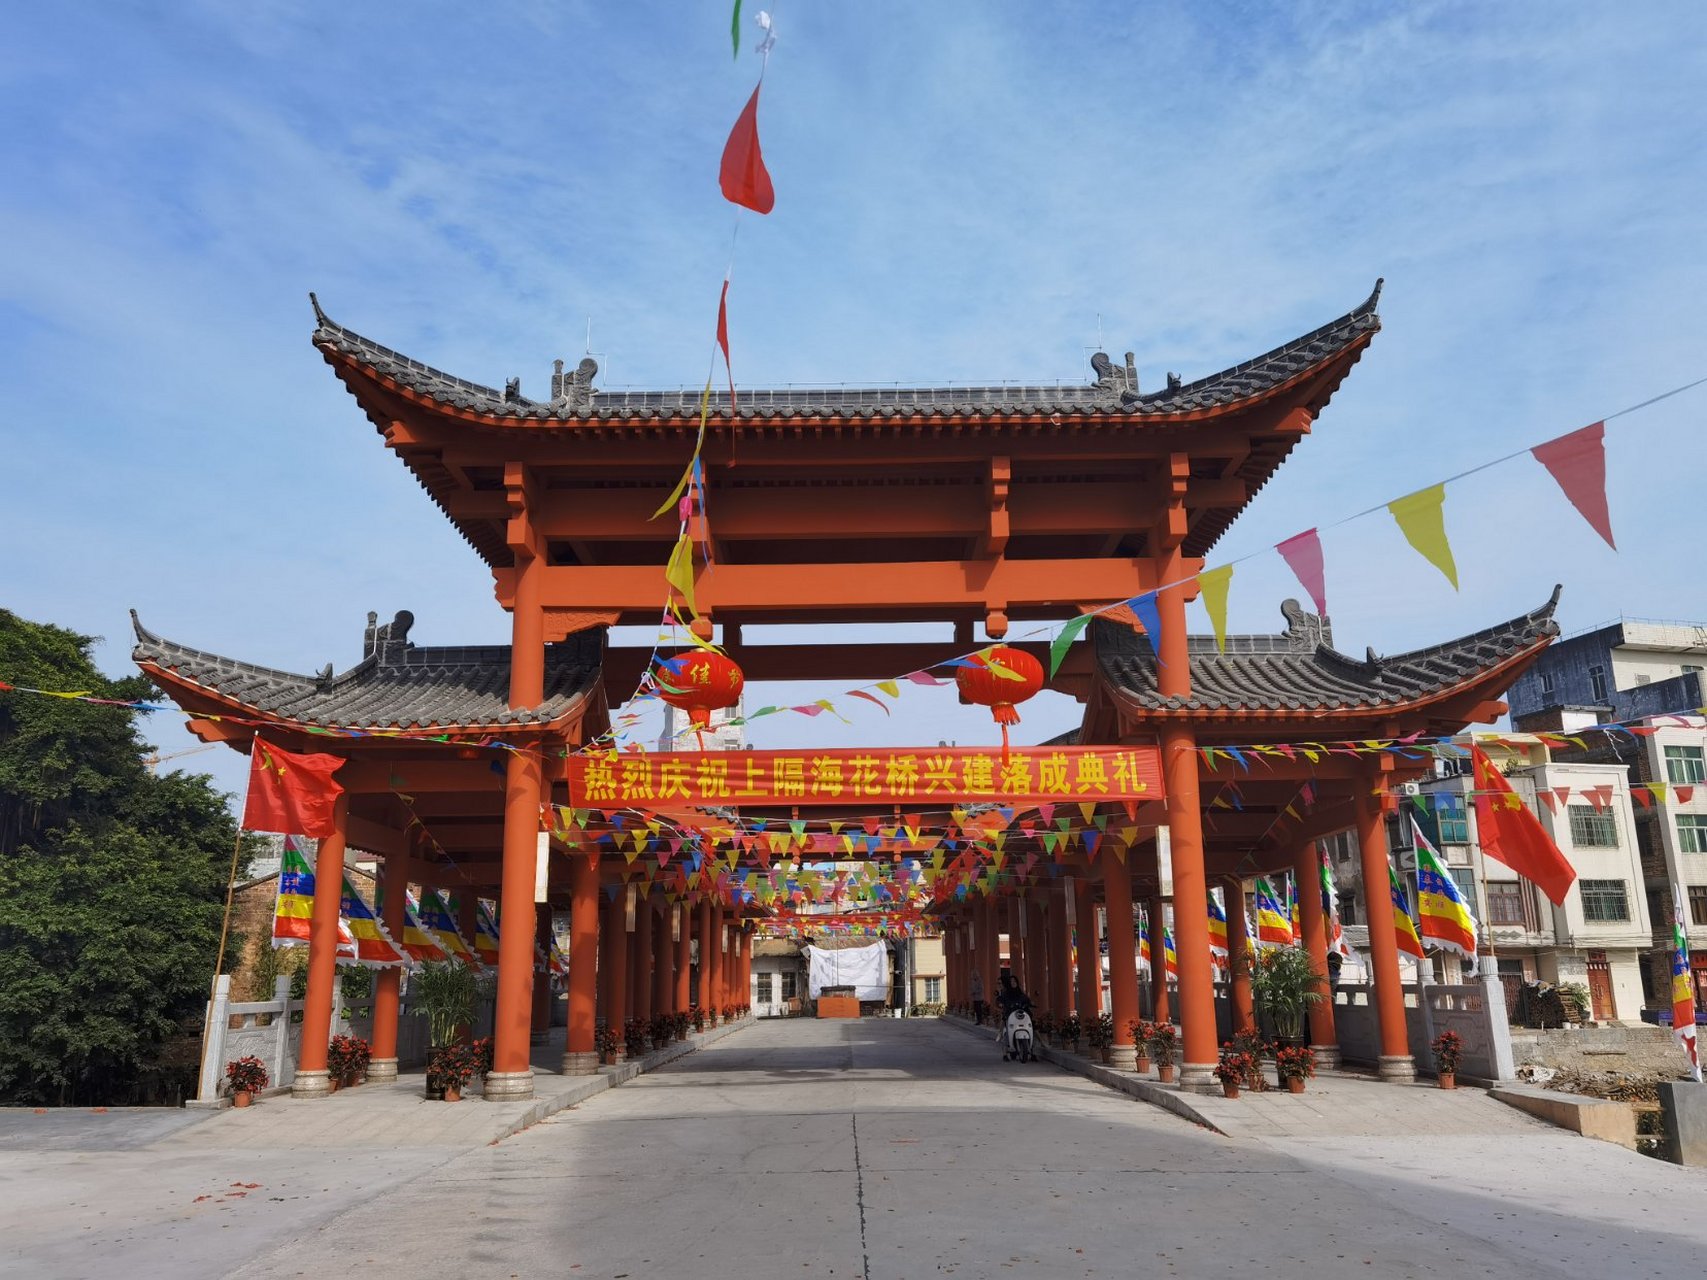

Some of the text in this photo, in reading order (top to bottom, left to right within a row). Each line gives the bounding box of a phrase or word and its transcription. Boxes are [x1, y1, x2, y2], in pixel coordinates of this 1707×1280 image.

[584, 752, 1148, 801] 热烈庆祝上隔海花桥兴建落成典礼
